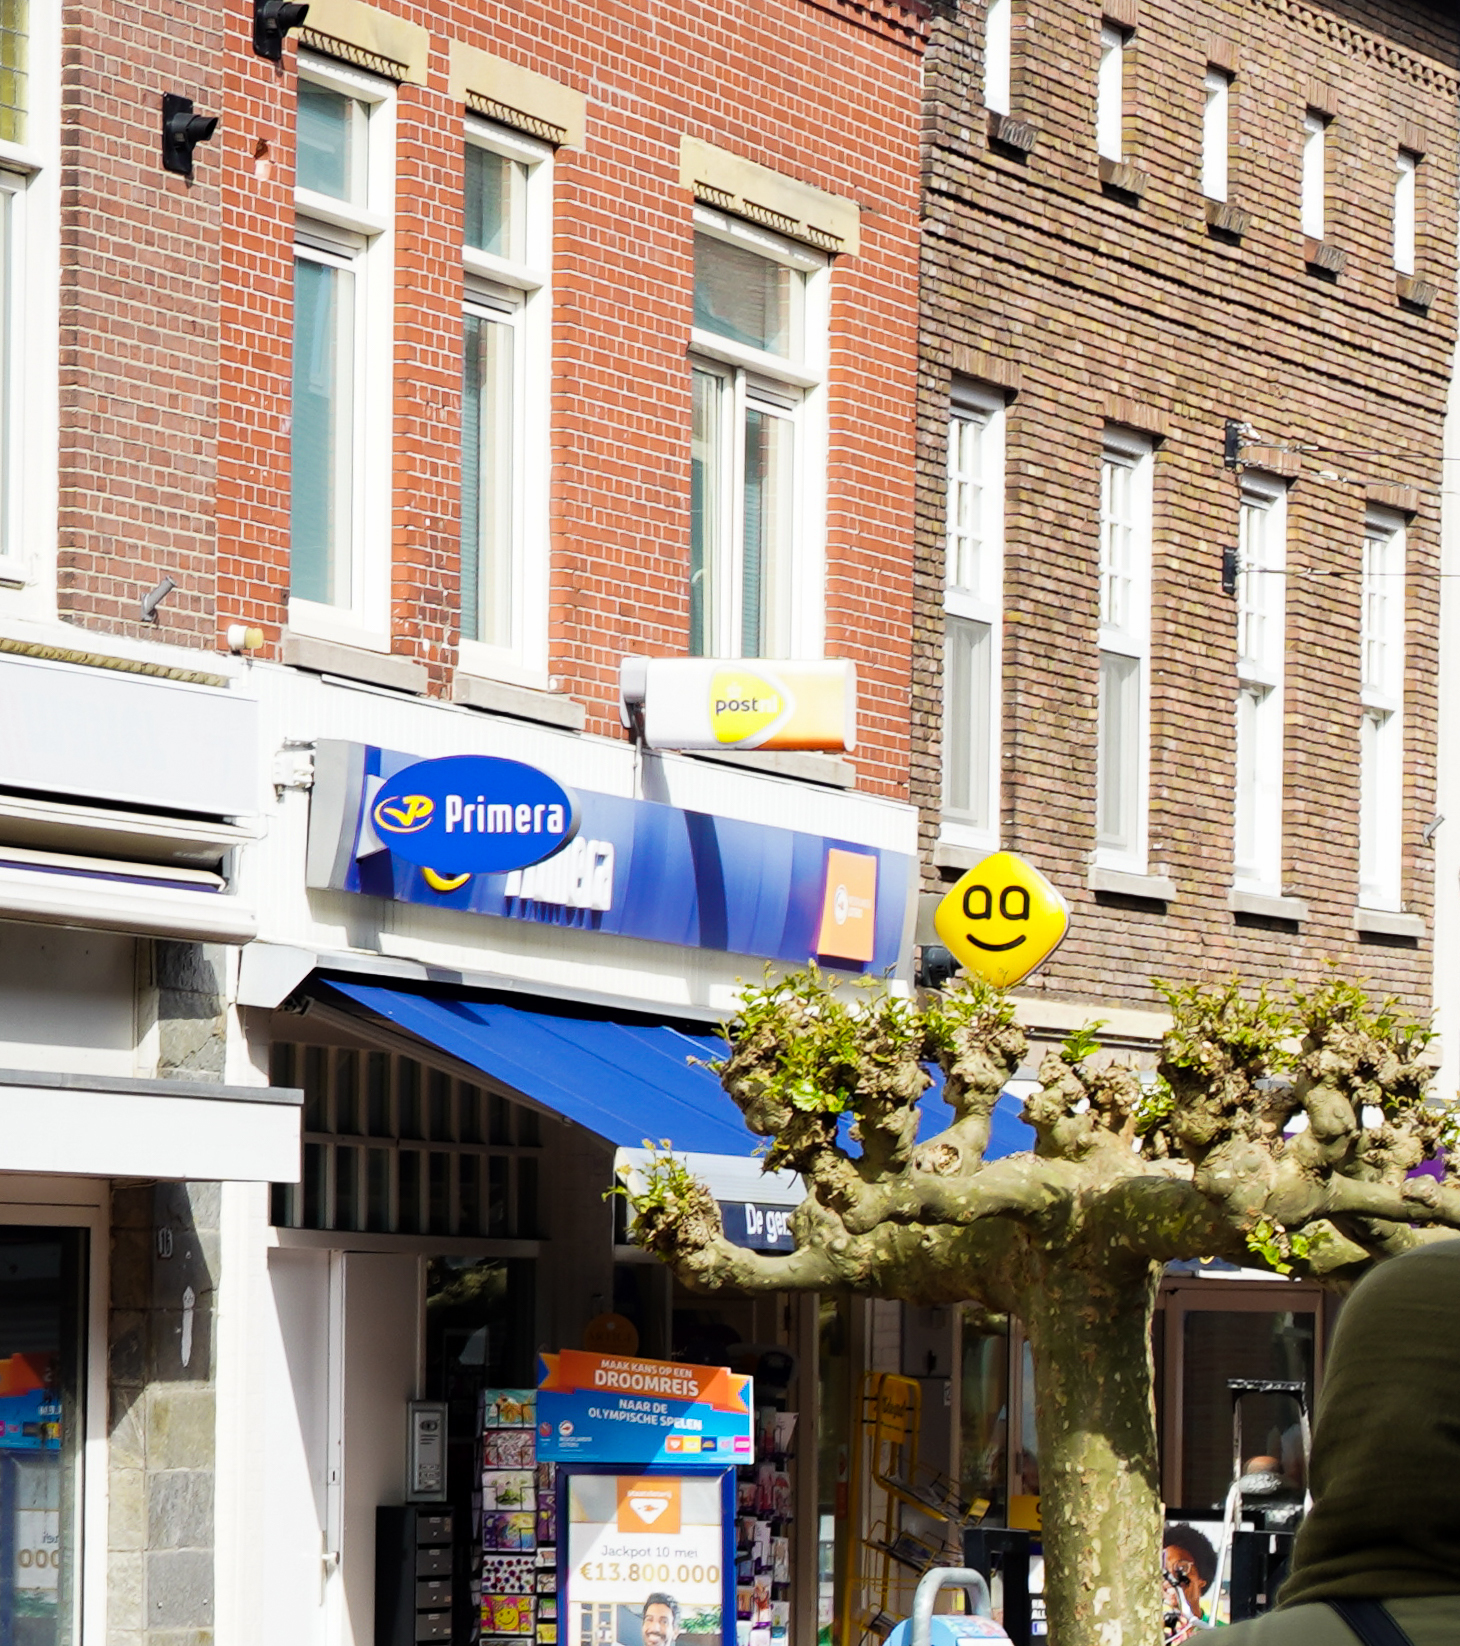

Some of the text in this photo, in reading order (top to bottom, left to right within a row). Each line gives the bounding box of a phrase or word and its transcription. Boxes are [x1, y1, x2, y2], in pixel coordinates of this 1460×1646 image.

[446, 794, 564, 834] Primera
[745, 1203, 764, 1235] De
[601, 1359, 693, 1379] MAAK KANS OP EEN
[594, 1369, 700, 1398] DROOMREIS
[619, 1399, 668, 1414] NAAR DE
[588, 1407, 702, 1431] OLYMPISCHE SPELEN
[601, 1545, 699, 1560] Jackpot 10 mei
[580, 1562, 721, 1585] €13.800.000
